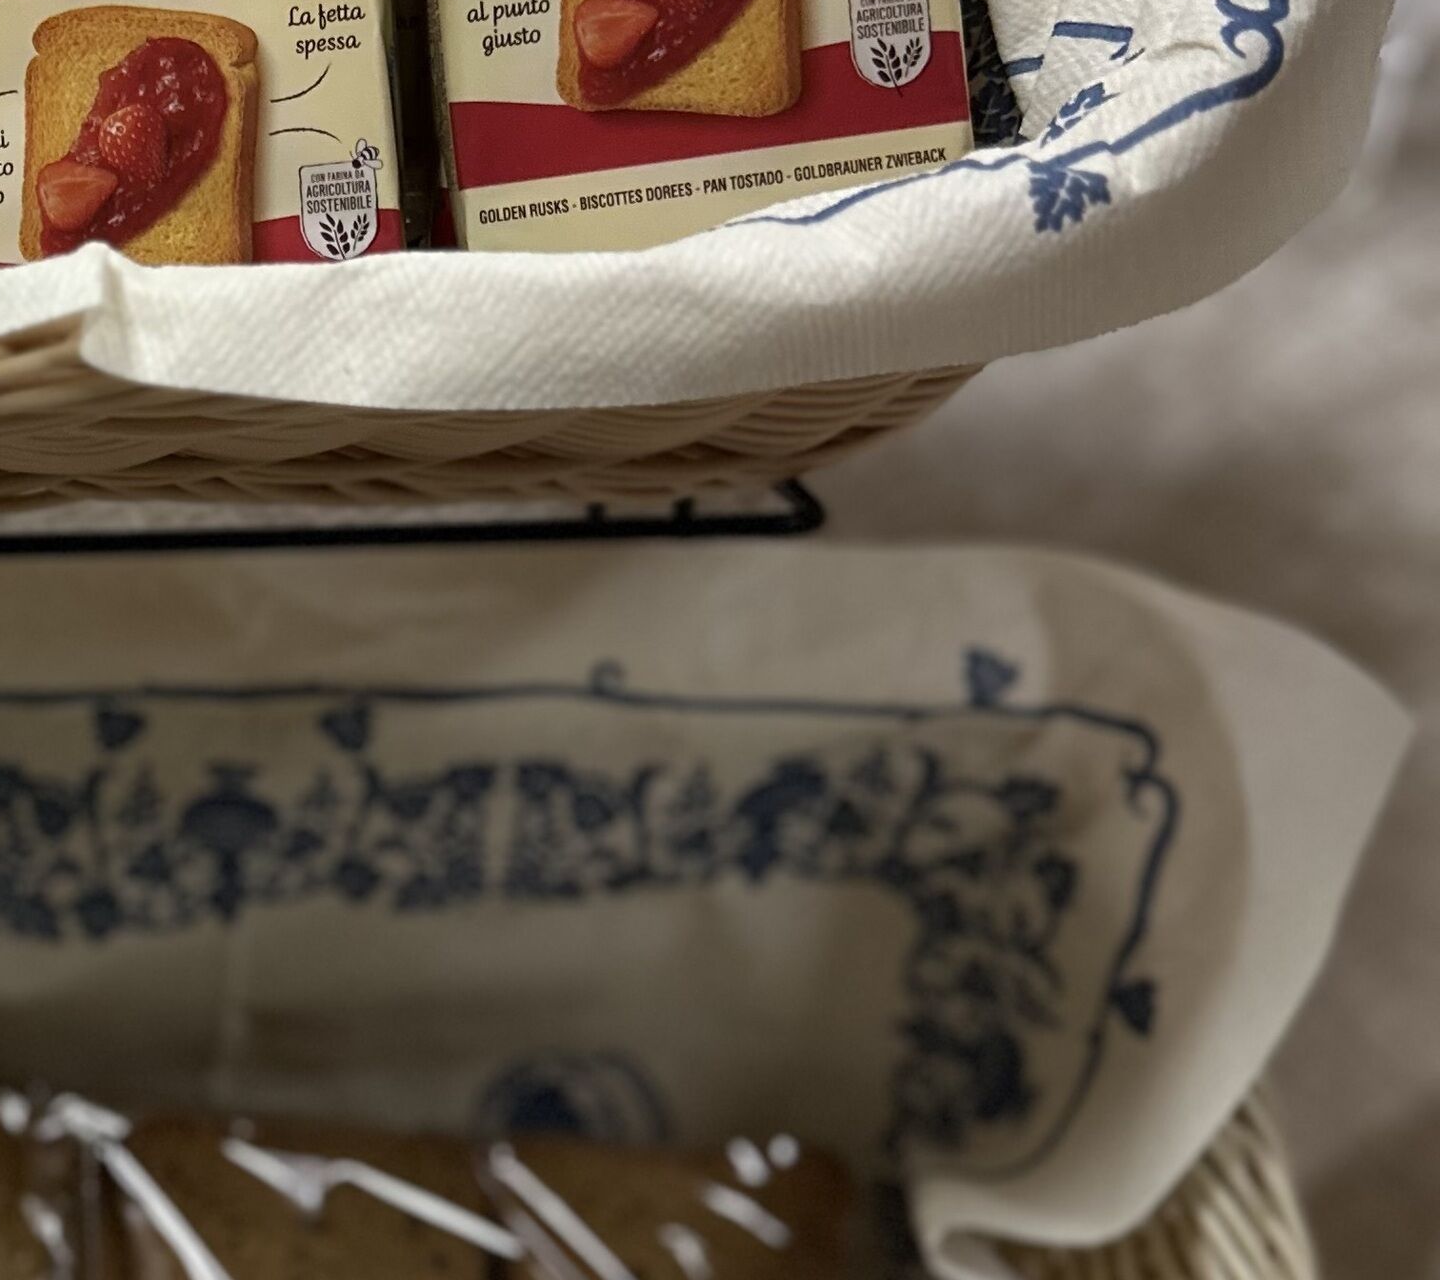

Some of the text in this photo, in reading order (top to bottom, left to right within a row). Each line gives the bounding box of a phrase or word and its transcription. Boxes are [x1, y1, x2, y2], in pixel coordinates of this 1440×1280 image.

[288, 3, 366, 31] La fetta
[467, 1, 488, 23] al
[857, 3, 923, 23] AGRICOLTURA
[857, 17, 925, 39] SOSTENIBILE
[295, 33, 361, 59] spessa
[481, 27, 541, 56] giusto
[311, 169, 364, 183] CON FARINA DA
[479, 206, 527, 224] GOLDEN
[529, 199, 569, 219] RUSKS
[579, 189, 643, 211] BISCOTTES
[645, 183, 693, 202] DOREES
[703, 177, 727, 194] PAN
[730, 170, 784, 190] TOSTADO
[794, 156, 883, 182] GOLDBRAUNER
[885, 147, 947, 170] ZWIEBACK
[306, 180, 371, 199] AGRICOLTURA
[307, 195, 372, 214] SOSTENIBILE
